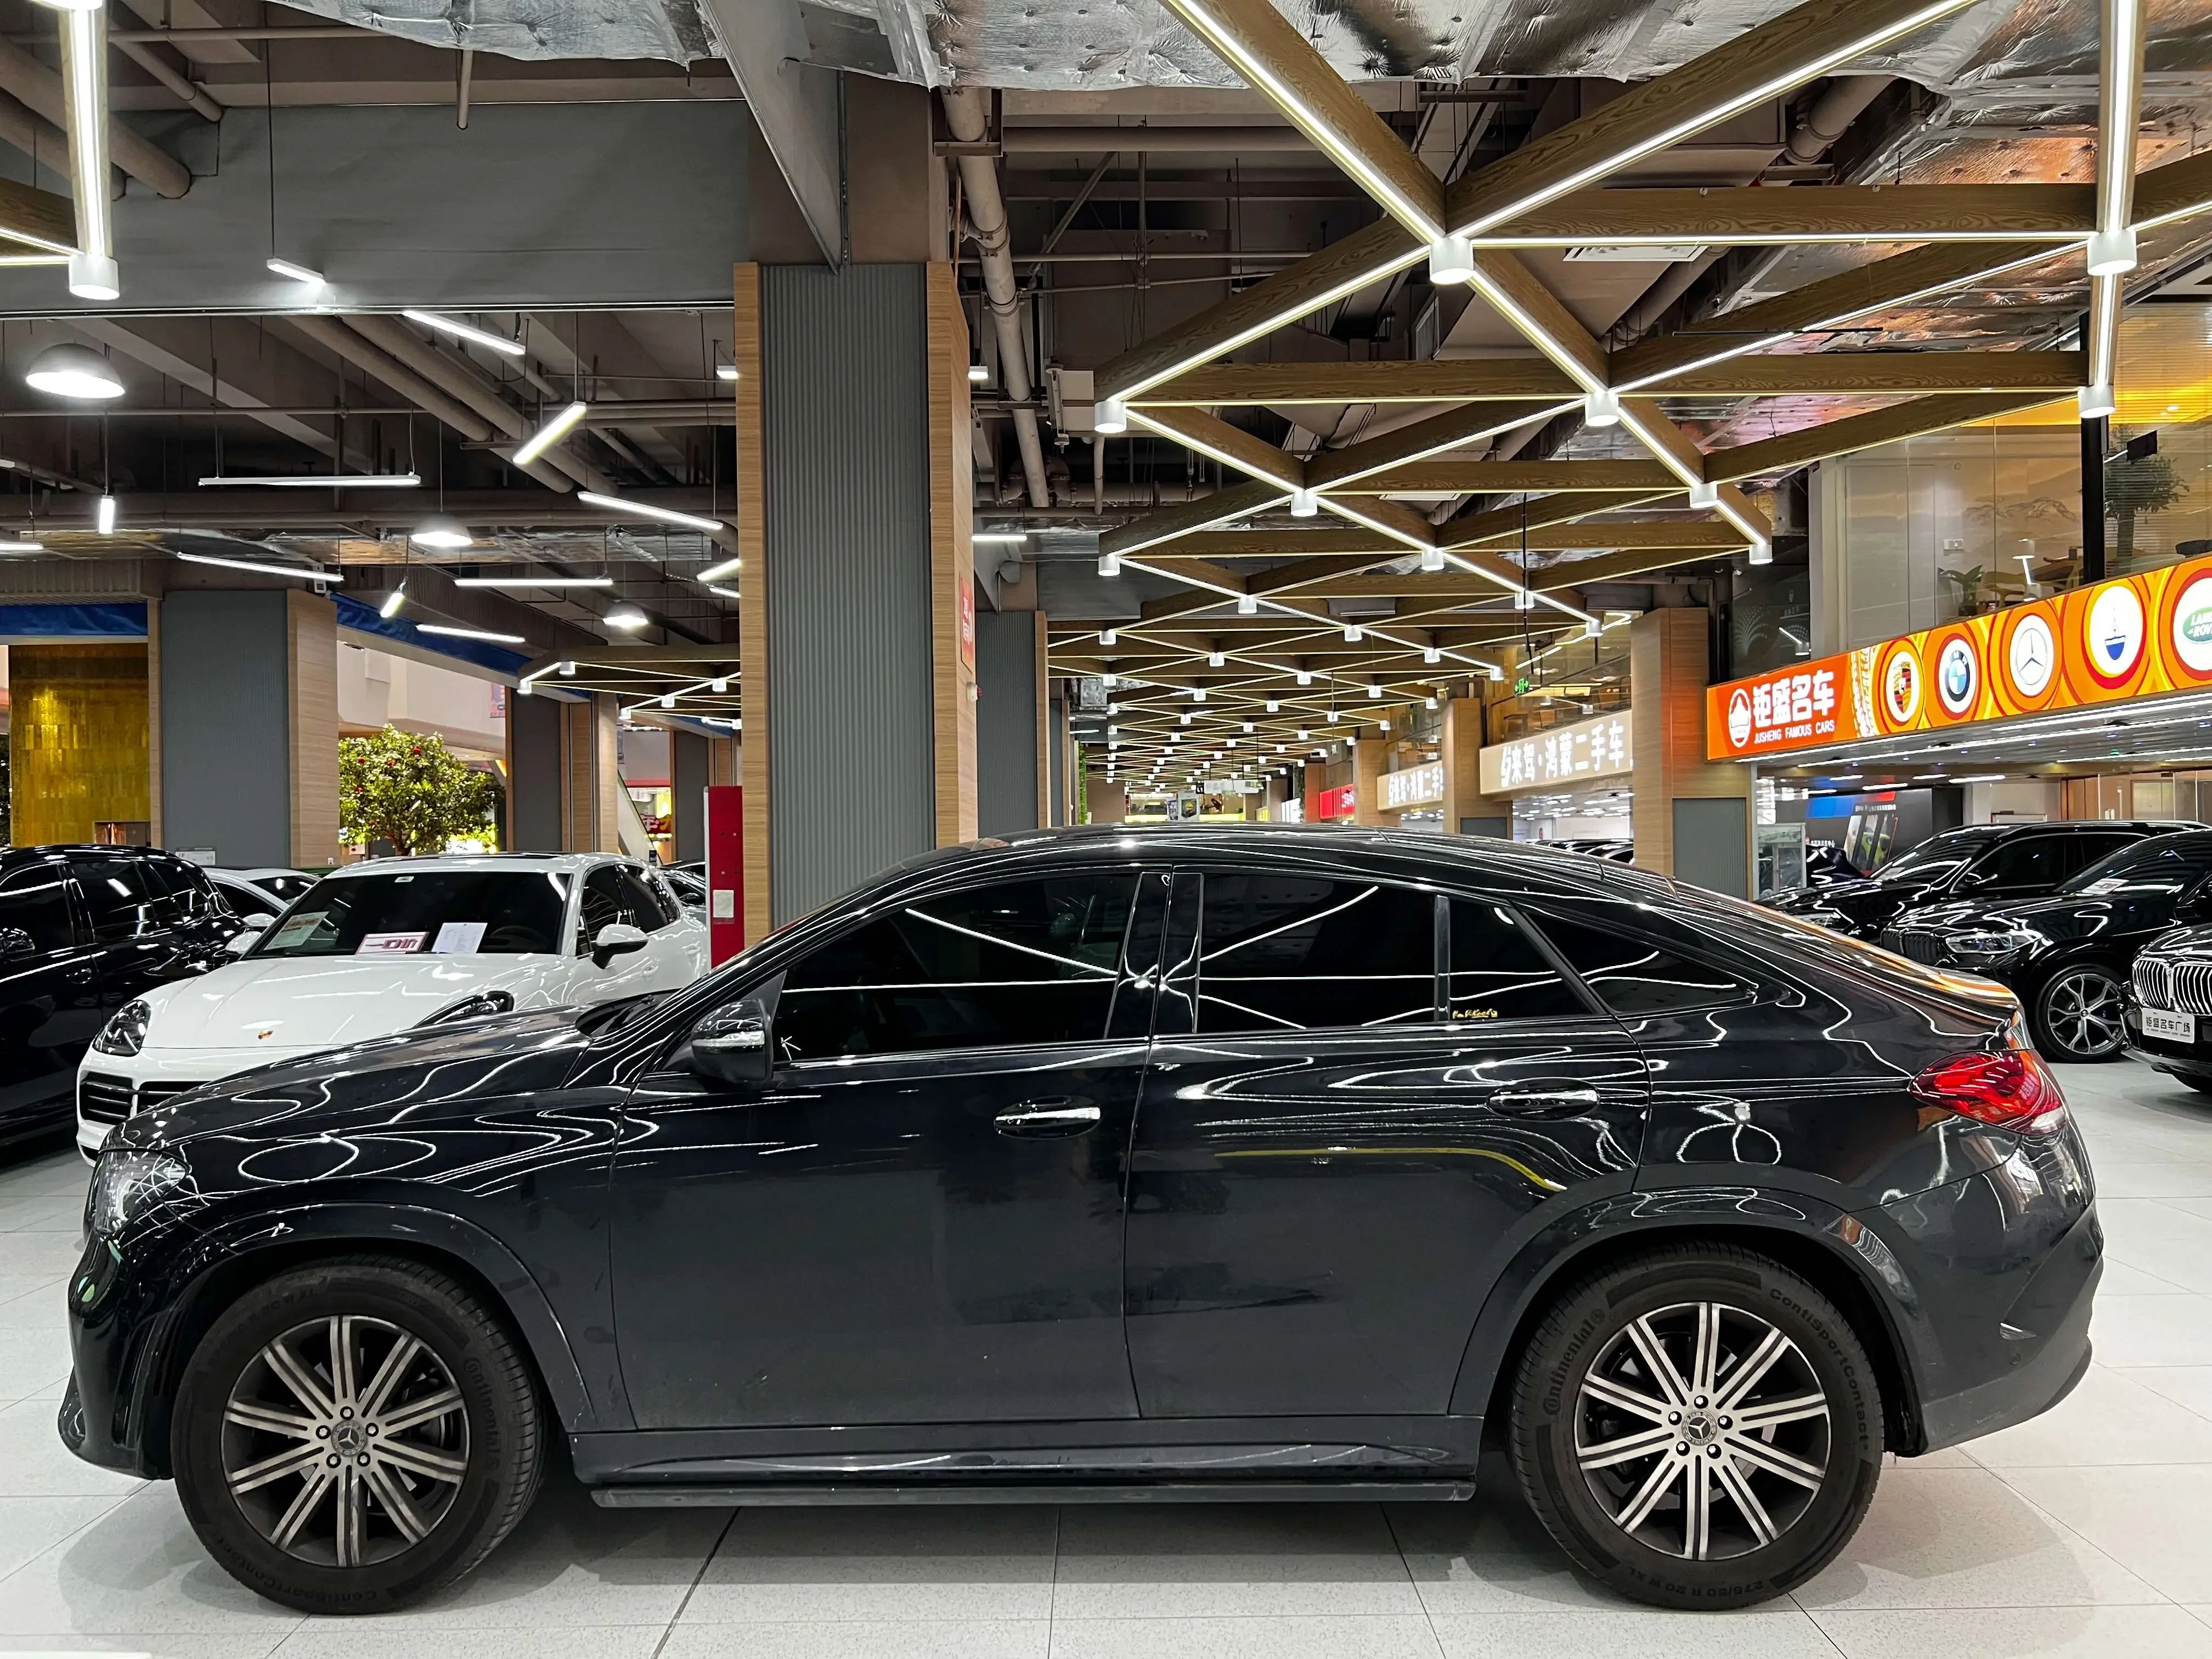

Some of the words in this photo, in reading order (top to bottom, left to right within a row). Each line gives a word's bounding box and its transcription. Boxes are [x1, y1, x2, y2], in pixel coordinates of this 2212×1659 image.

[2193, 622, 2212, 637] ROV
[1753, 669, 1835, 728] 钜盛名车
[1754, 728, 1782, 744] JUSHENG
[1785, 723, 1812, 738] FAMOUS
[1815, 719, 1835, 735] CARS
[1543, 1317, 1598, 1415] Continental
[1770, 1288, 1869, 1442] ContiSportContact
[464, 1357, 499, 1455] Continental
